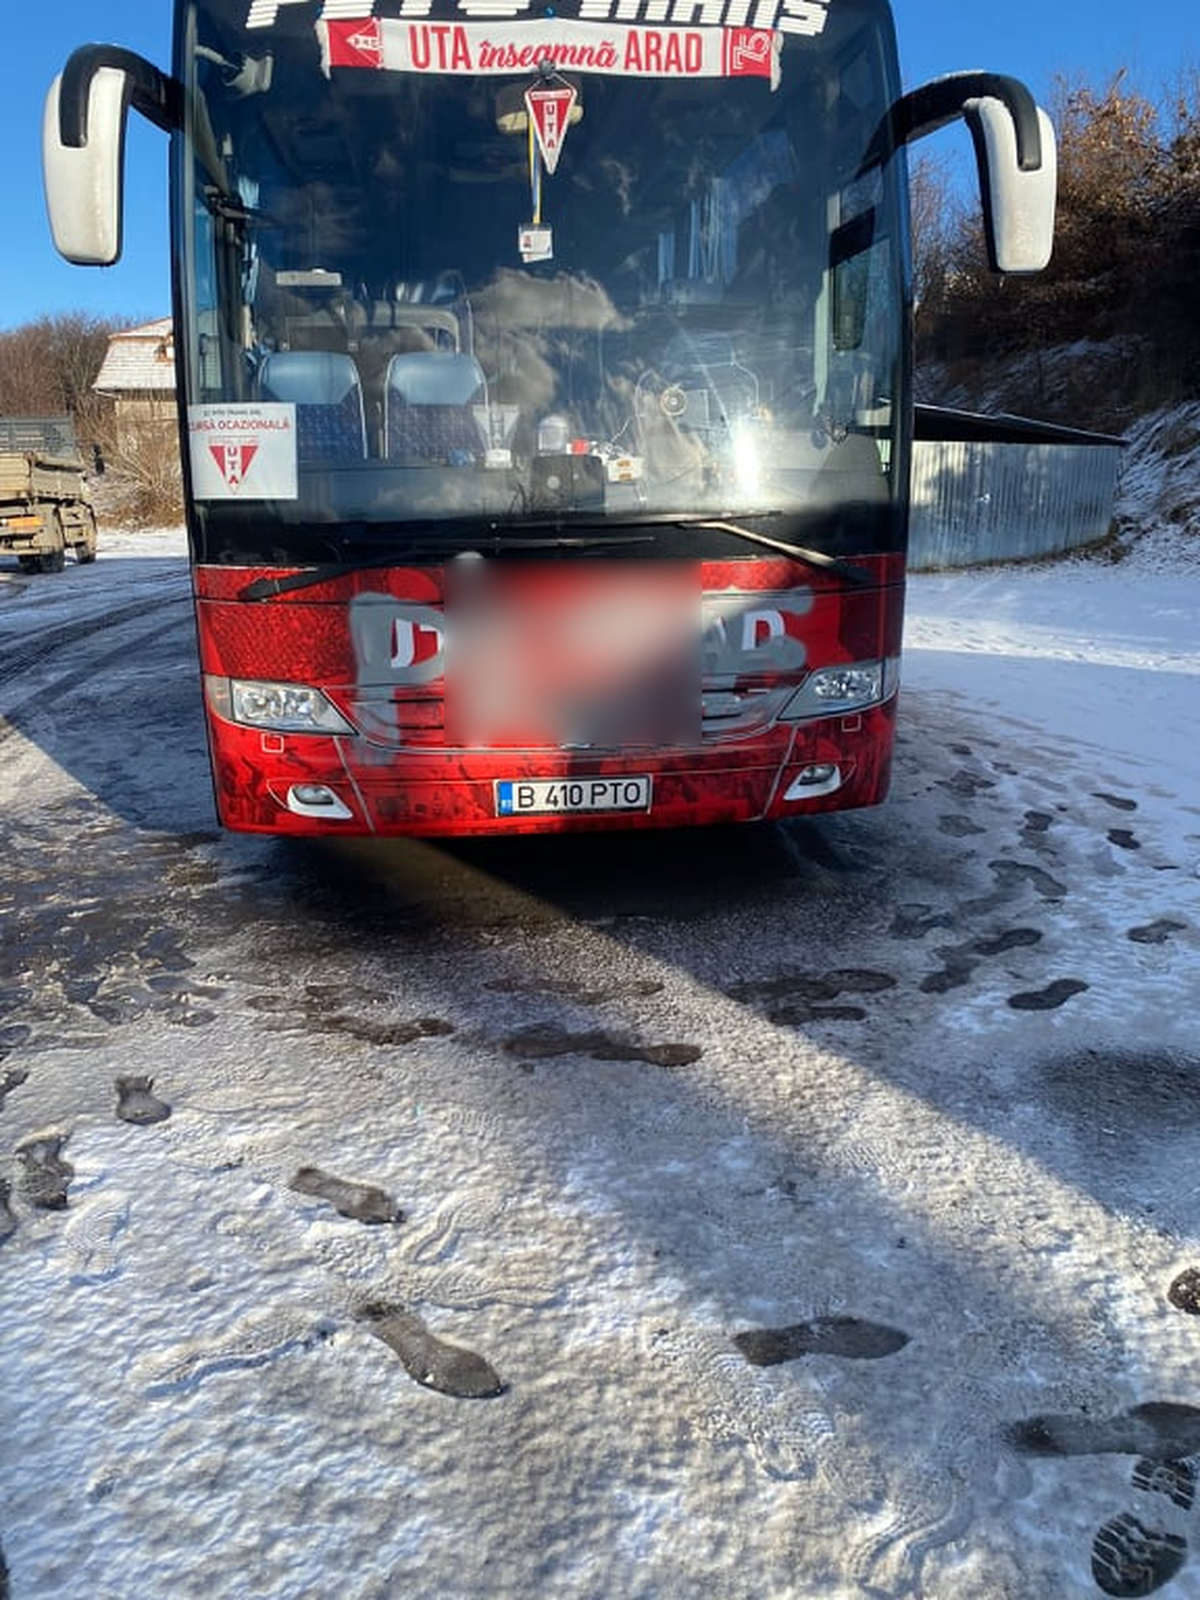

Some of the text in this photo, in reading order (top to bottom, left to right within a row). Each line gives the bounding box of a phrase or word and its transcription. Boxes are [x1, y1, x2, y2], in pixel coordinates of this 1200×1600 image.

[408, 25, 473, 70] UTA
[624, 30, 703, 73] ARAD
[518, 786, 535, 808] B
[546, 784, 583, 806] 410
[591, 782, 641, 805] PTO
